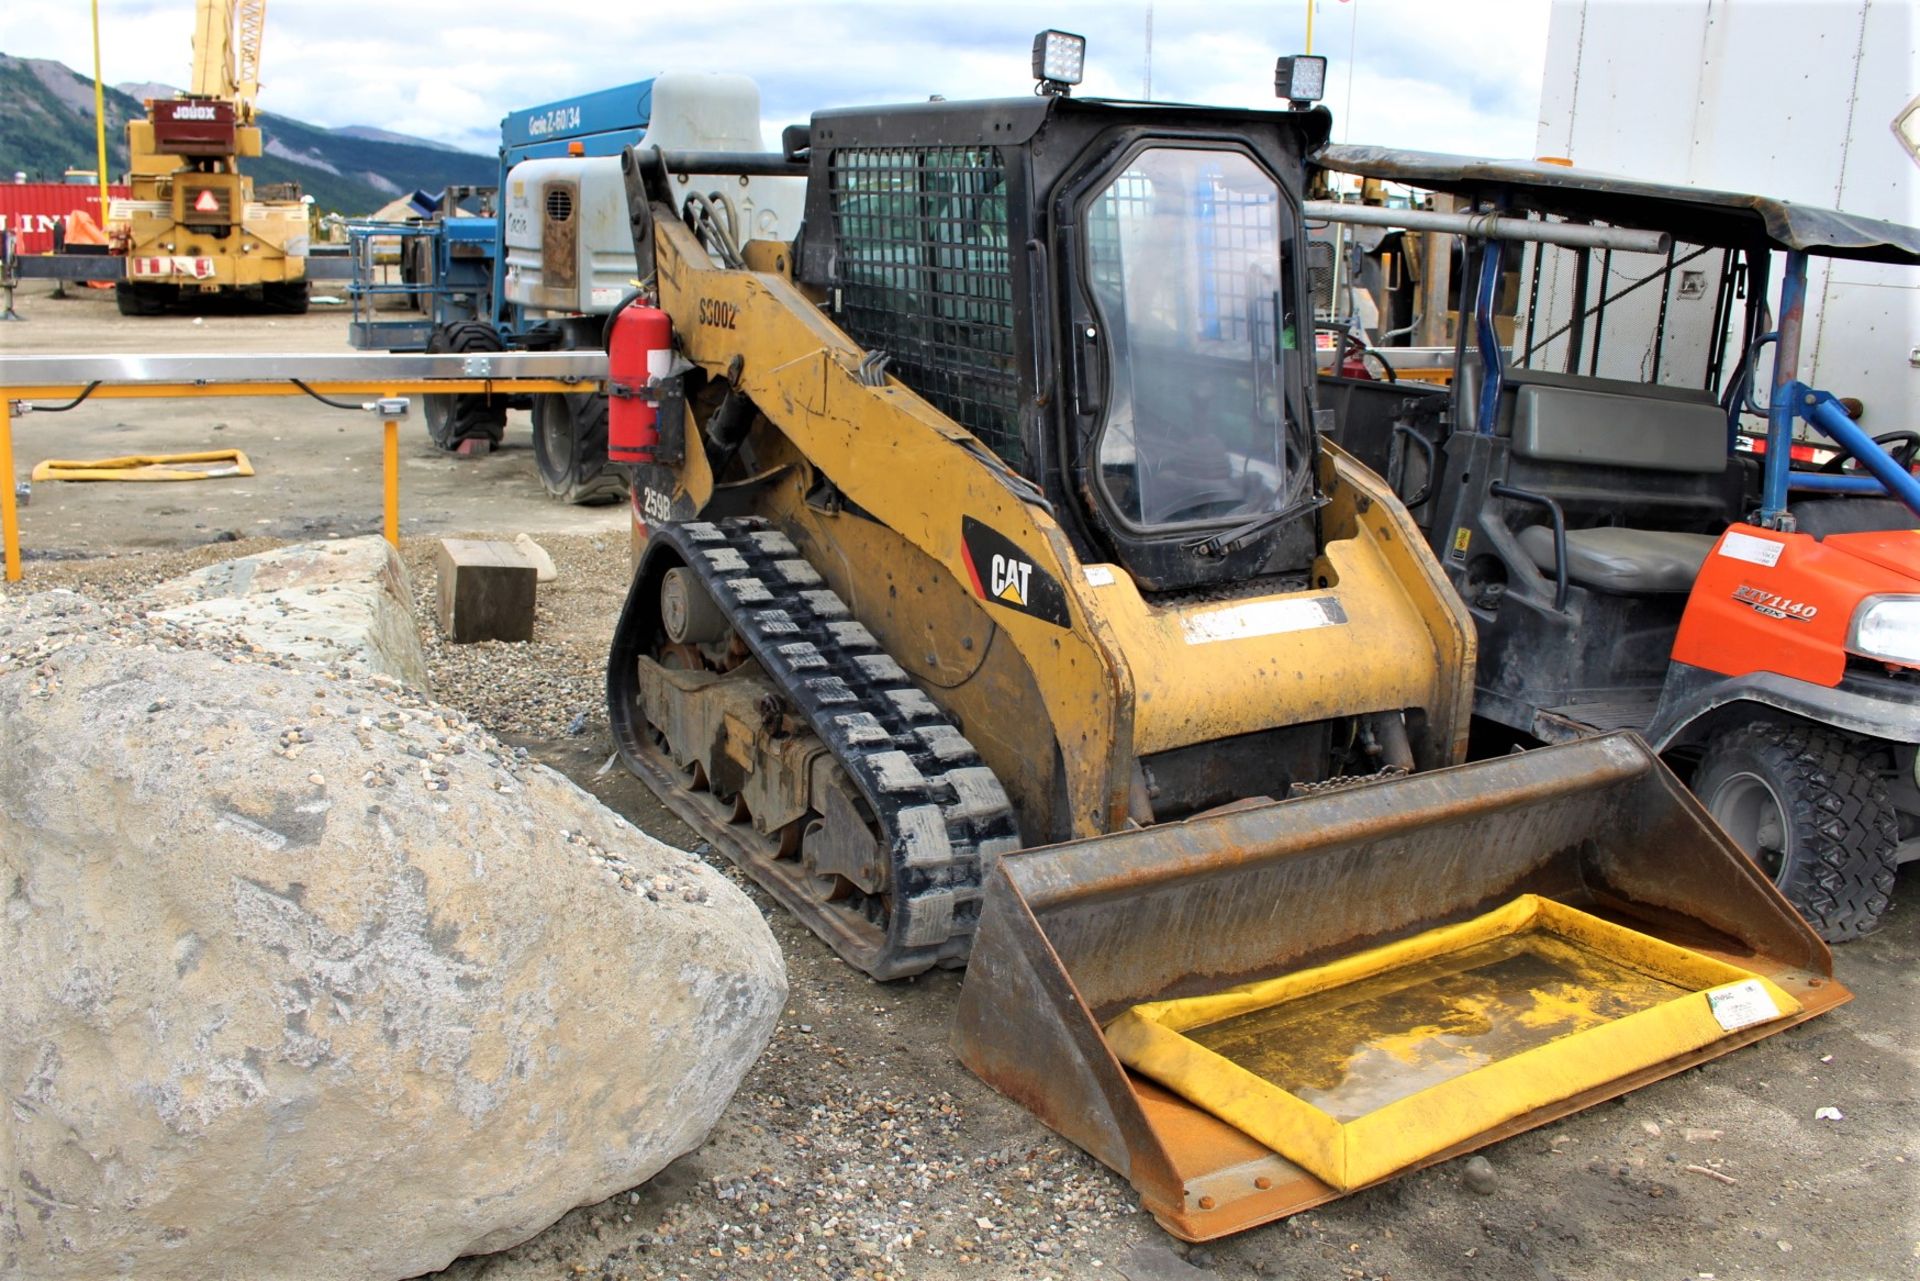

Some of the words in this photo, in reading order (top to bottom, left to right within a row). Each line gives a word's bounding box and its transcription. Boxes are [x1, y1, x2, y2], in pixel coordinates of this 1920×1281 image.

[644, 486, 671, 522] 259B
[991, 553, 1033, 607] CAT
[1733, 585, 1818, 618] RTV1140
